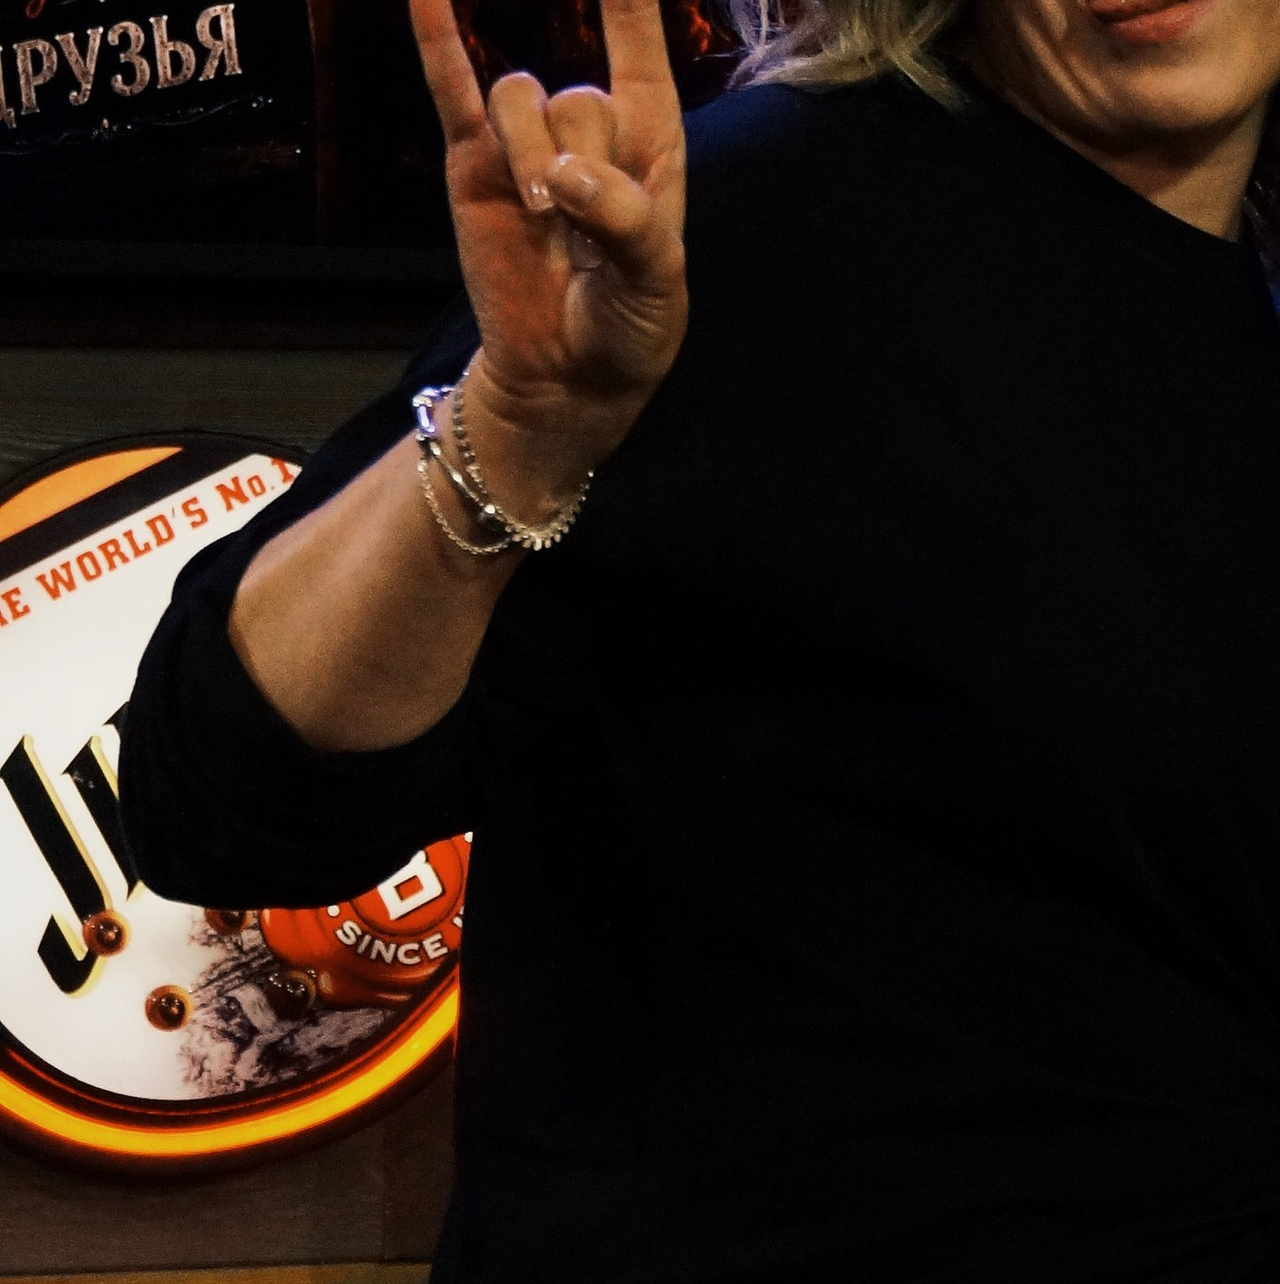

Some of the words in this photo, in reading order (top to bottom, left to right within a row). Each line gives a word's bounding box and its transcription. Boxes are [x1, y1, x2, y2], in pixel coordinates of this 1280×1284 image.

[0, 3, 243, 128] РУЗЬЯ
[35, 496, 209, 602] WORLD'S
[335, 920, 449, 967] SINCE
